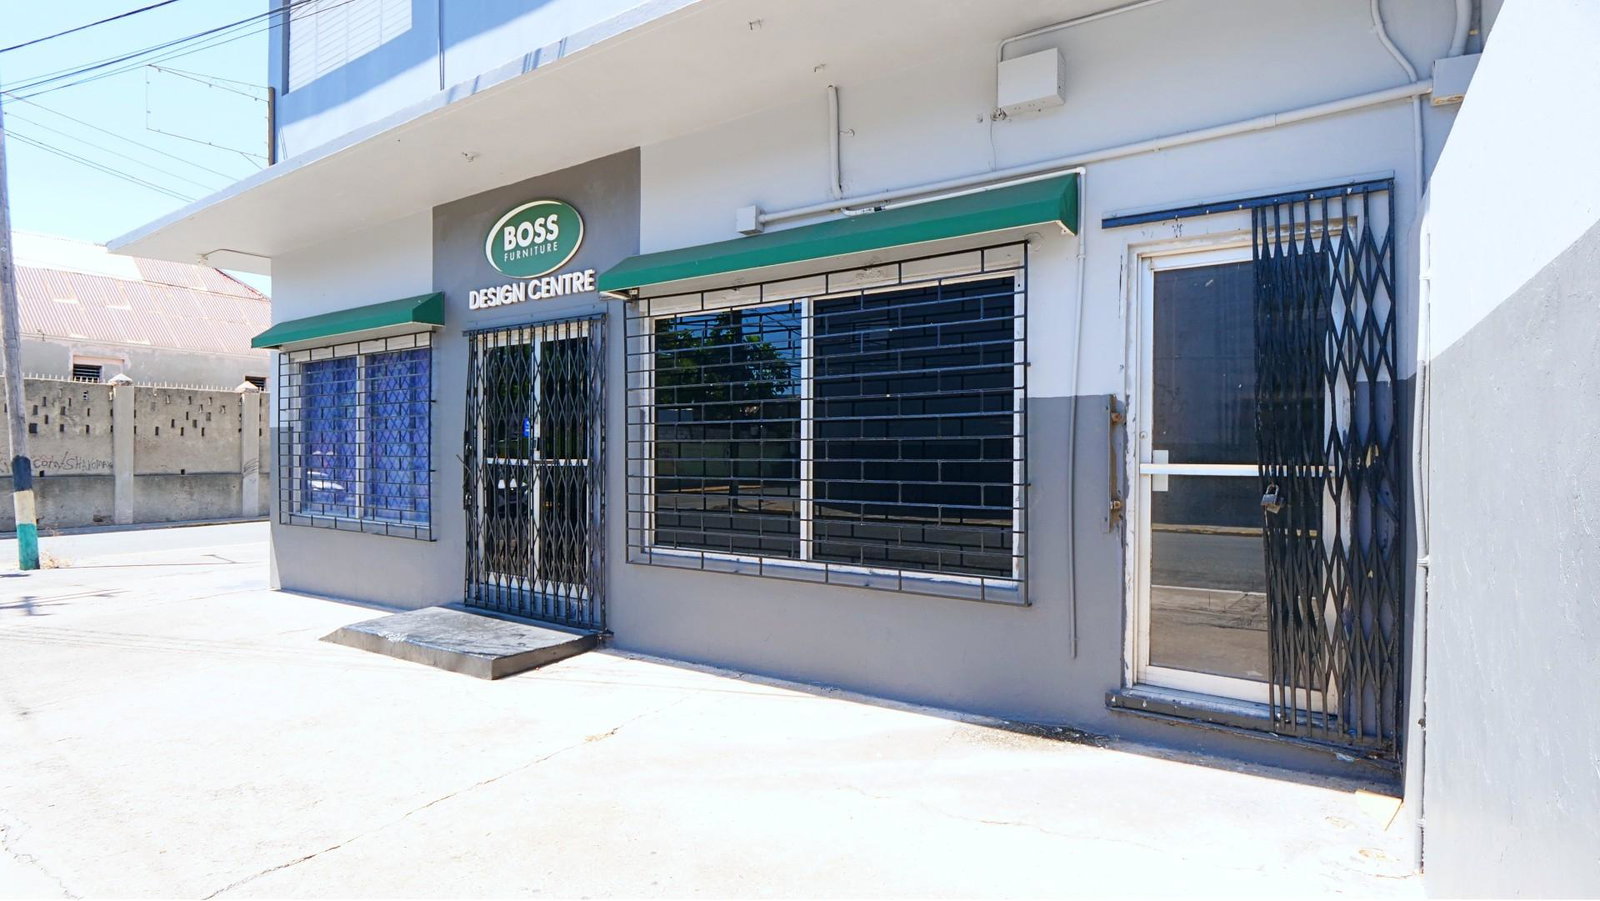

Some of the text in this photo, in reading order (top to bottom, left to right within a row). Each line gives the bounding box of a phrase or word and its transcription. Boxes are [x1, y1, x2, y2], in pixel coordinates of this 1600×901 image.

[504, 214, 559, 251] BOSS
[504, 242, 558, 262] FURNITURE
[469, 269, 596, 310] DESIGN CENTRE
